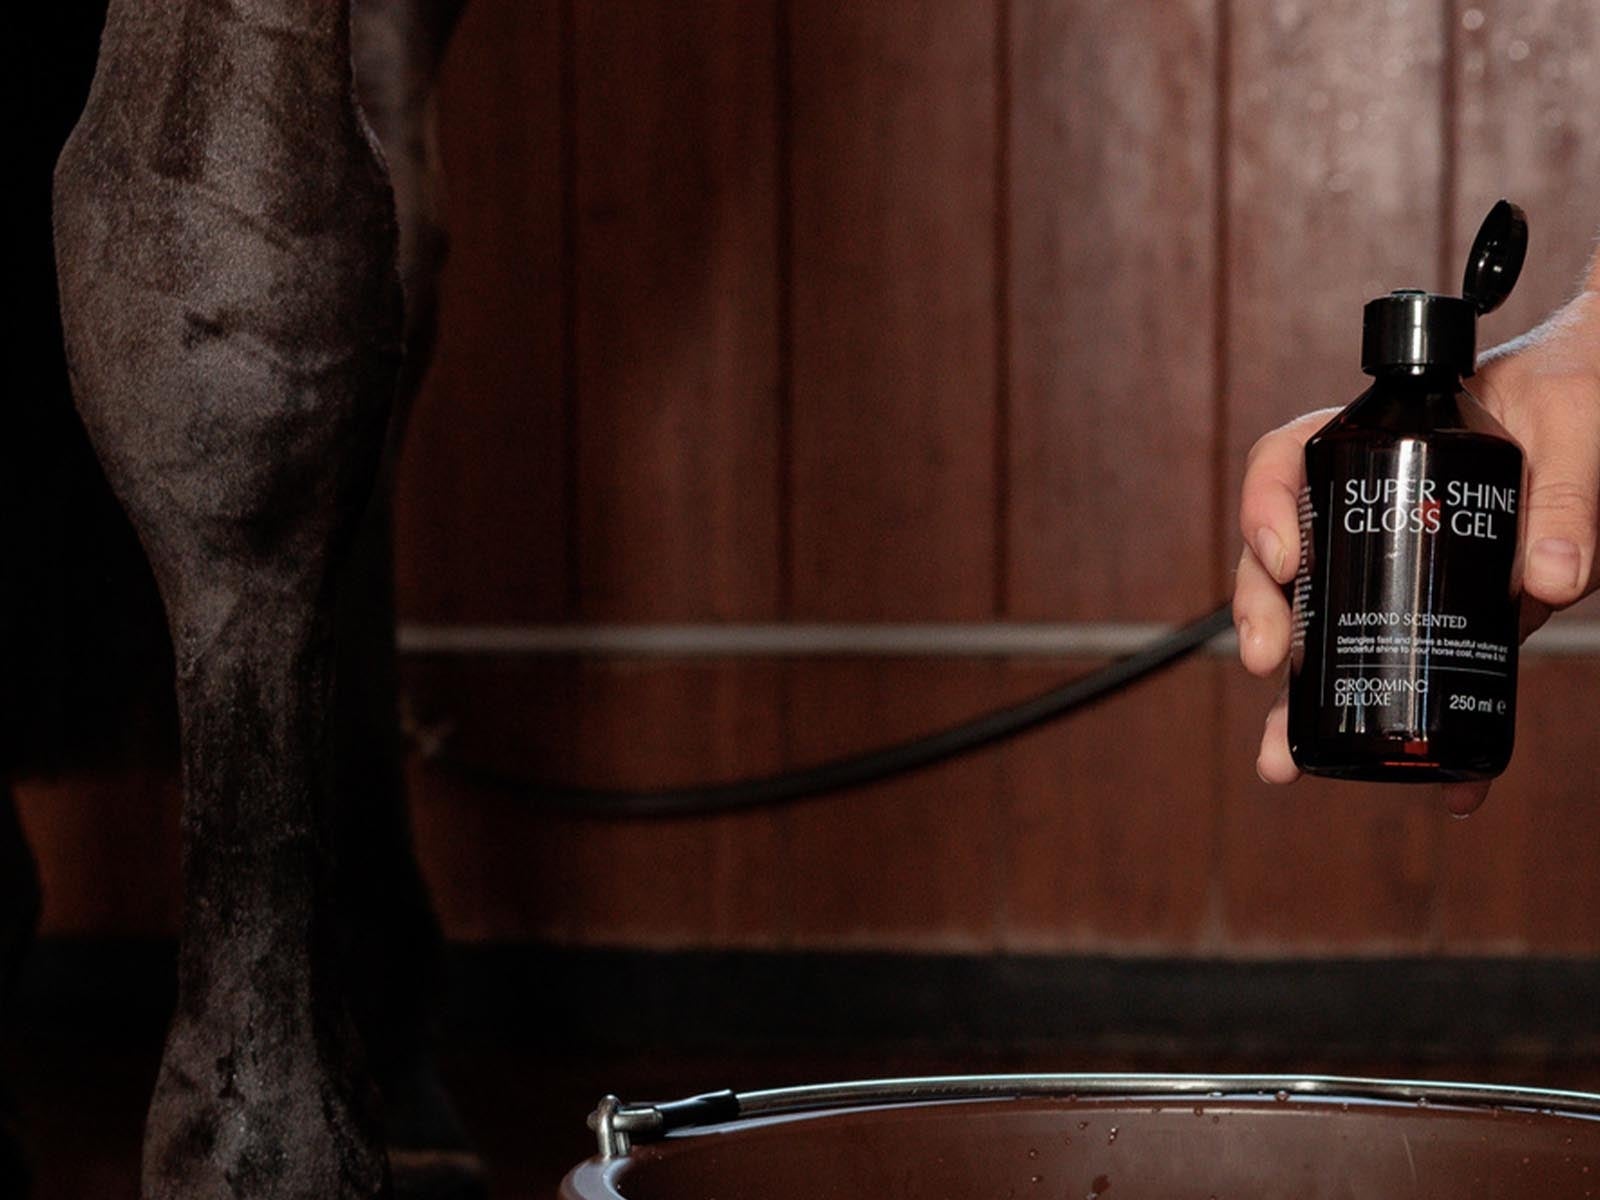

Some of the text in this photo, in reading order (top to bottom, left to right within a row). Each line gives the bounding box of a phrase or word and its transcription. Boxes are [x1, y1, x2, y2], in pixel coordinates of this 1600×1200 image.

[1344, 479, 1516, 514] SUPER SHINE
[1343, 507, 1498, 540] GLOSS GEL
[1337, 612, 1468, 629] ALMOND SCENTED
[1337, 636, 1375, 646] Detangles
[1394, 636, 1411, 645] and
[1444, 638, 1476, 648] beautiful
[1336, 645, 1375, 654] wonderful
[1376, 645, 1399, 654] shine
[1400, 645, 1410, 654] to
[1432, 647, 1454, 656] horse
[1334, 677, 1428, 693] GROOMING
[1335, 691, 1392, 706] DELUXE
[1449, 694, 1476, 711] 250
[1478, 698, 1493, 713] ml
